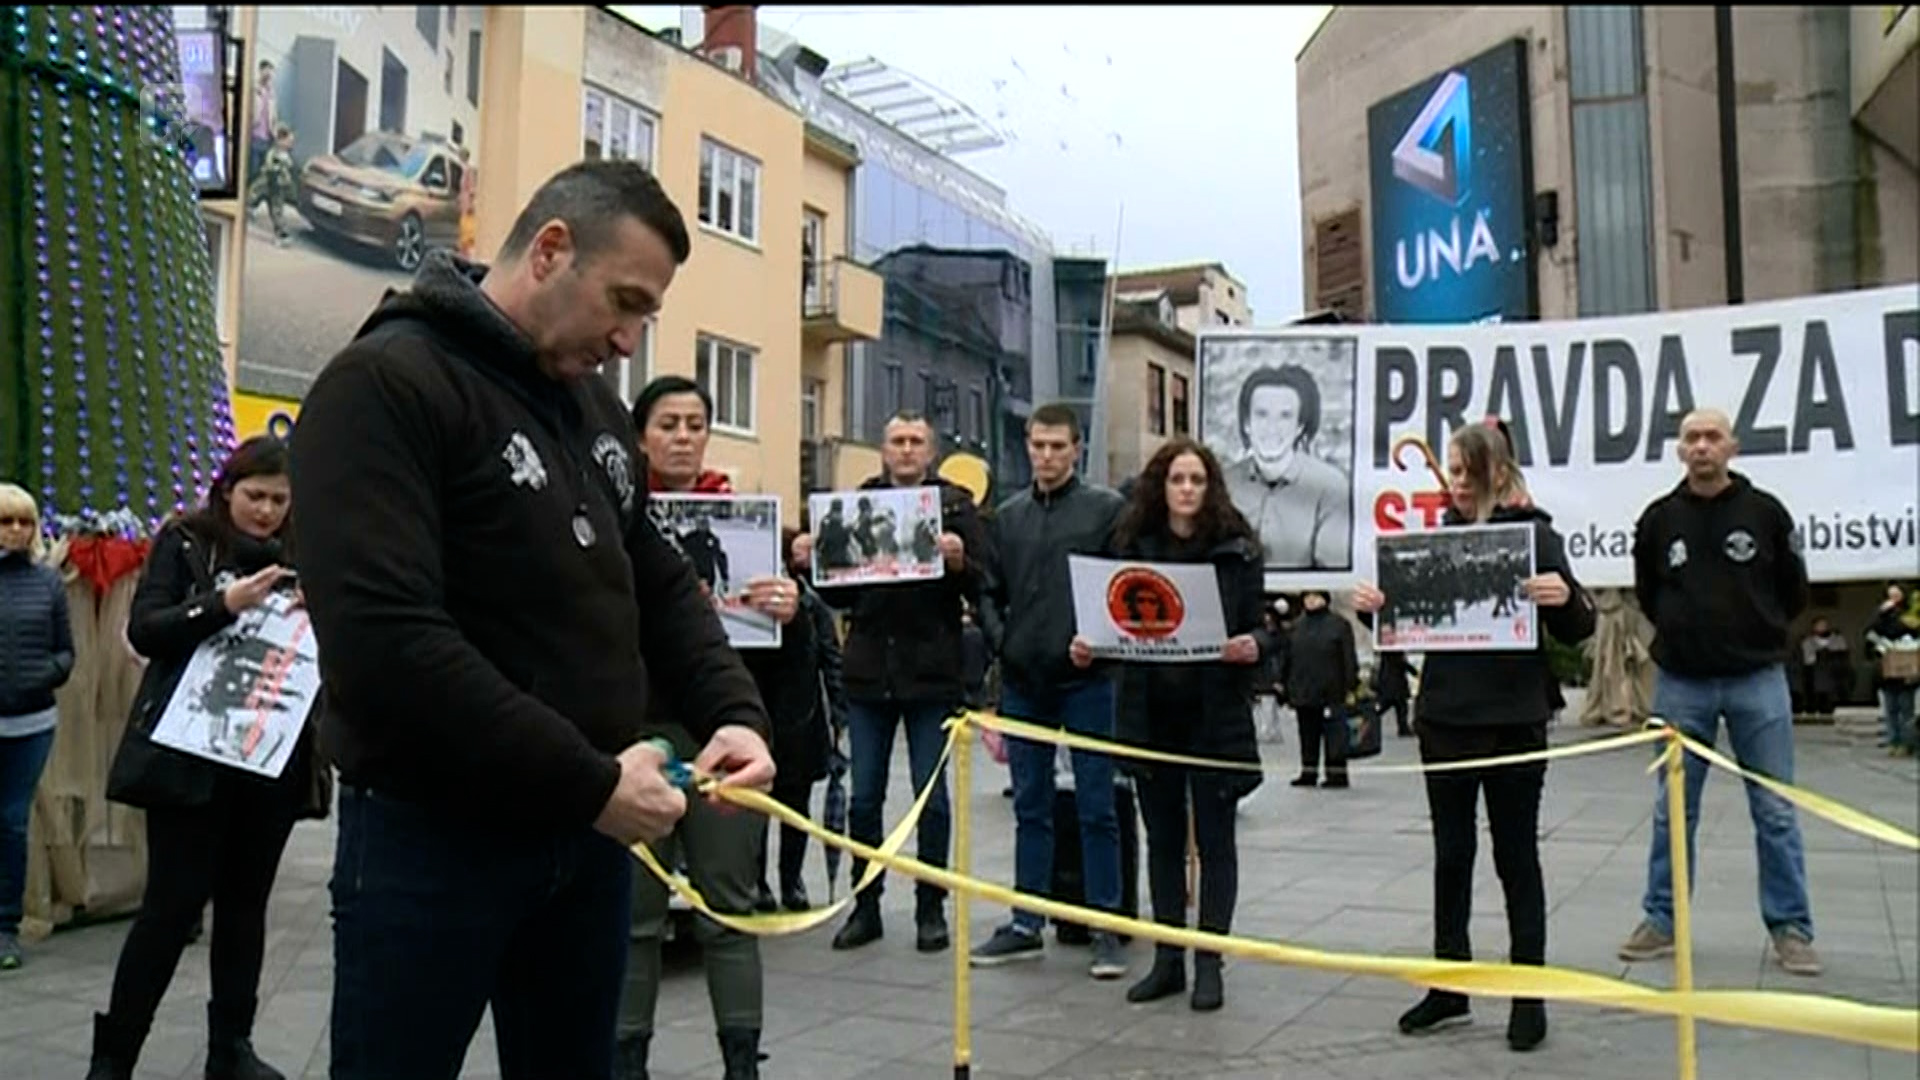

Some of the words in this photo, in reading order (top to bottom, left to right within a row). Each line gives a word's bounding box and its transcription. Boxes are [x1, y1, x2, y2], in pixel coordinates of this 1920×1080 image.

[1397, 209, 1500, 288] UNA
[1374, 335, 1698, 469] PRAVDA
[1731, 320, 1855, 456] ZA
[1374, 491, 1452, 530] ST
